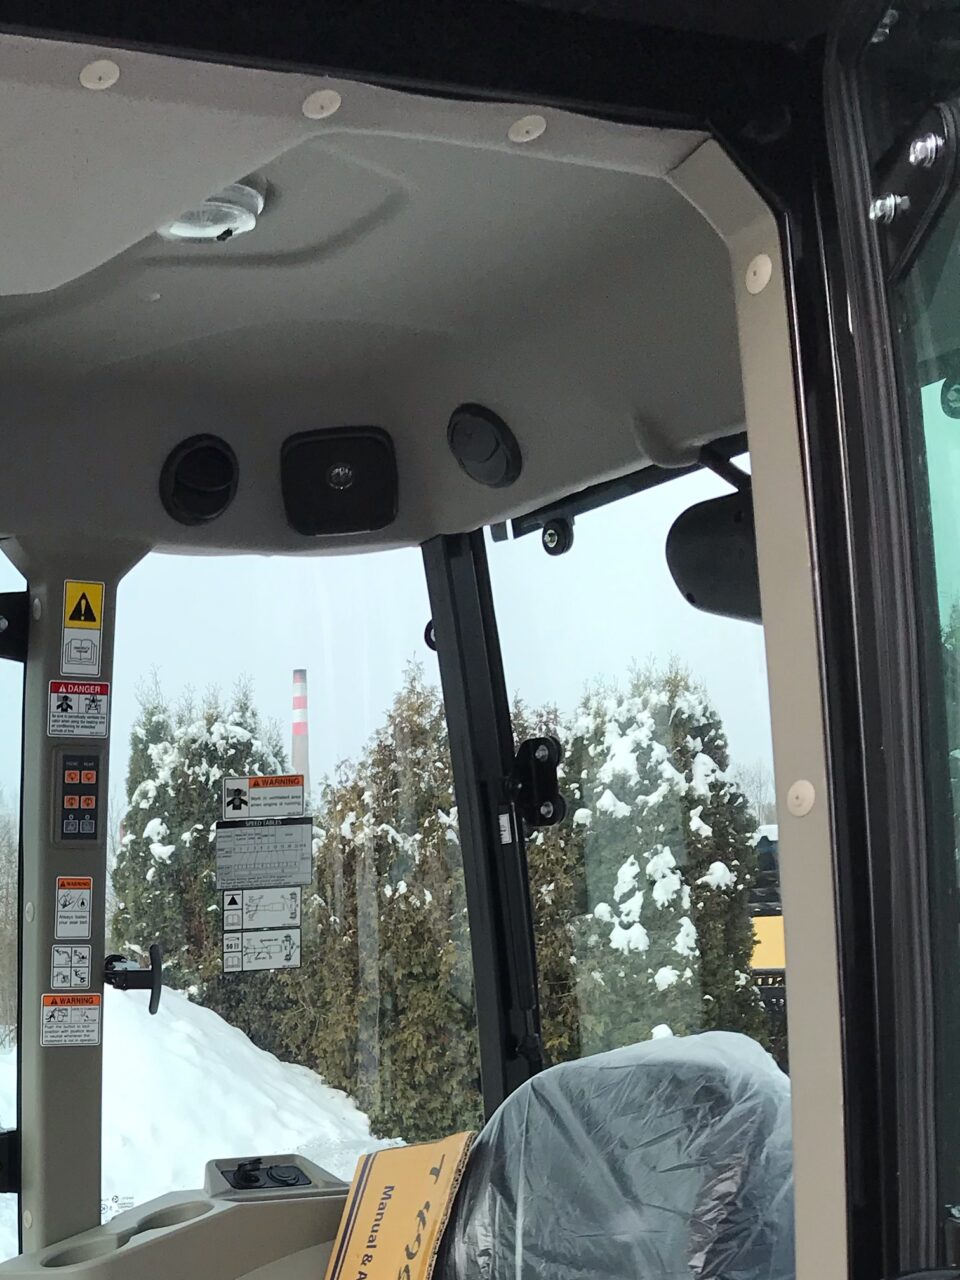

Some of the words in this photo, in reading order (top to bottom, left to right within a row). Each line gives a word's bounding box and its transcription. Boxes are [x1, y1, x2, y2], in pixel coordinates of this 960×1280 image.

[67, 684, 101, 694] DANGER
[261, 777, 300, 786] WARNING
[60, 997, 94, 1005] WARNING
[365, 1185, 395, 1248] Manual
[361, 1253, 373, 1267] &
